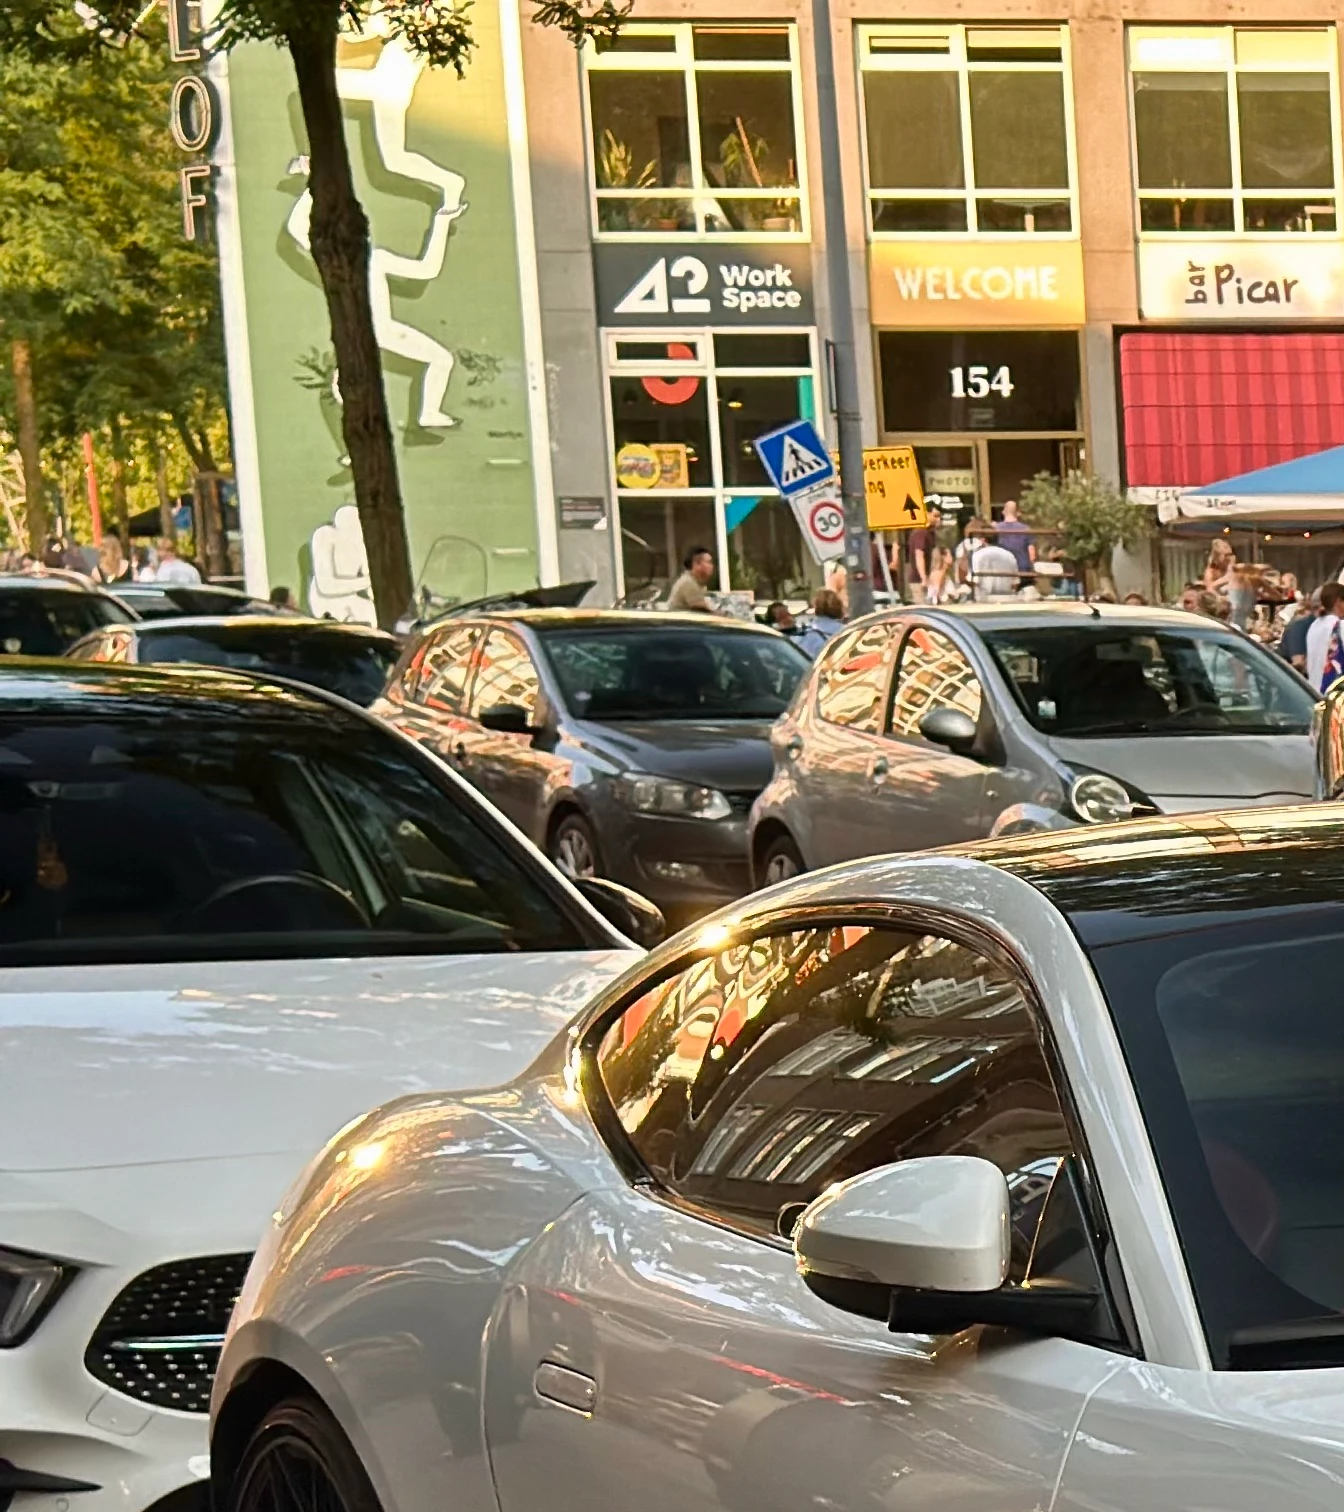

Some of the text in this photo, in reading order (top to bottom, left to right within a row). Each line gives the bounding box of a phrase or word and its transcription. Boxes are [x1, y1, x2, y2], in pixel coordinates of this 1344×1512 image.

[719, 264, 793, 287] Work
[894, 266, 1059, 301] WELCOME
[1185, 260, 1299, 305] bar Picar
[722, 287, 802, 312] Space
[949, 366, 1015, 398] 154
[817, 512, 841, 532] 30
